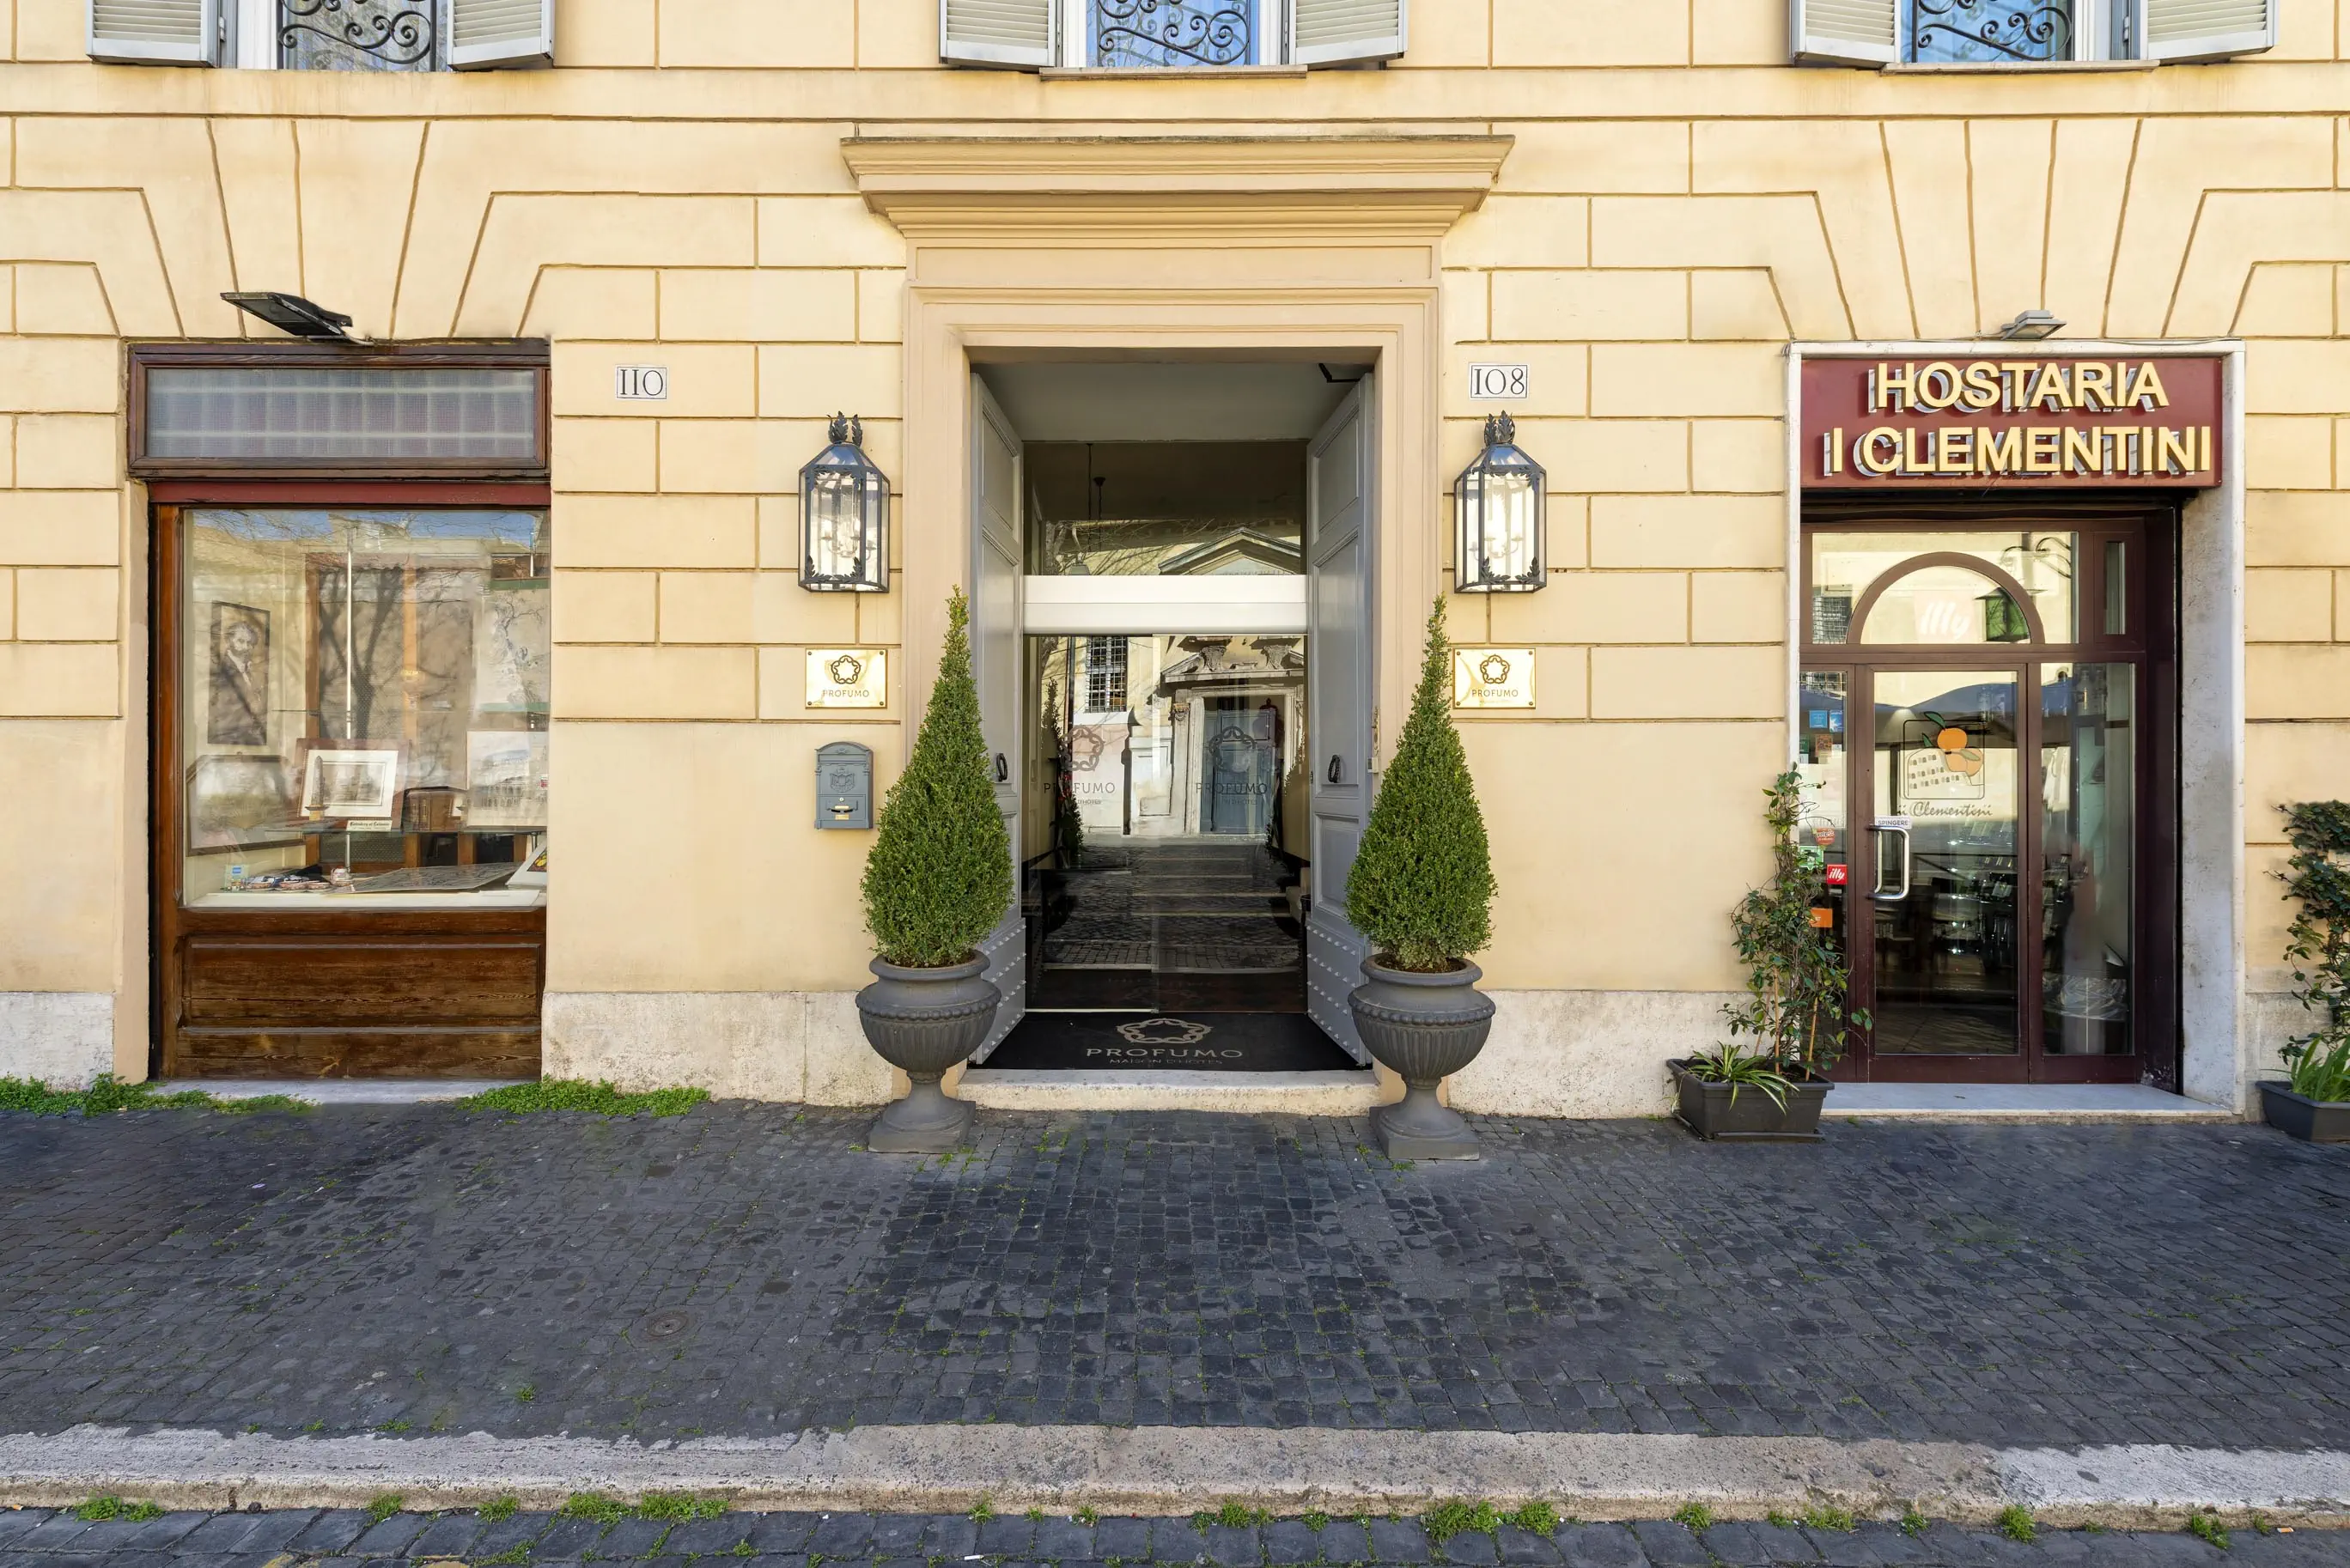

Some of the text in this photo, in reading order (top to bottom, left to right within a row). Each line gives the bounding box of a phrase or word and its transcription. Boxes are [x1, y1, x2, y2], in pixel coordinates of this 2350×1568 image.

[619, 368, 664, 397] 110
[1473, 368, 1525, 395] 108
[1875, 361, 2170, 410] HOSTARIA
[1830, 425, 2212, 473] I CLEMENTINI
[1471, 689, 1519, 697] PROFUMO
[1044, 782, 1116, 793] PFUMO
[1196, 782, 1268, 793] PROFUMO
[1829, 868, 1844, 881] illy
[1087, 1048, 1243, 1058] PROFUMO
